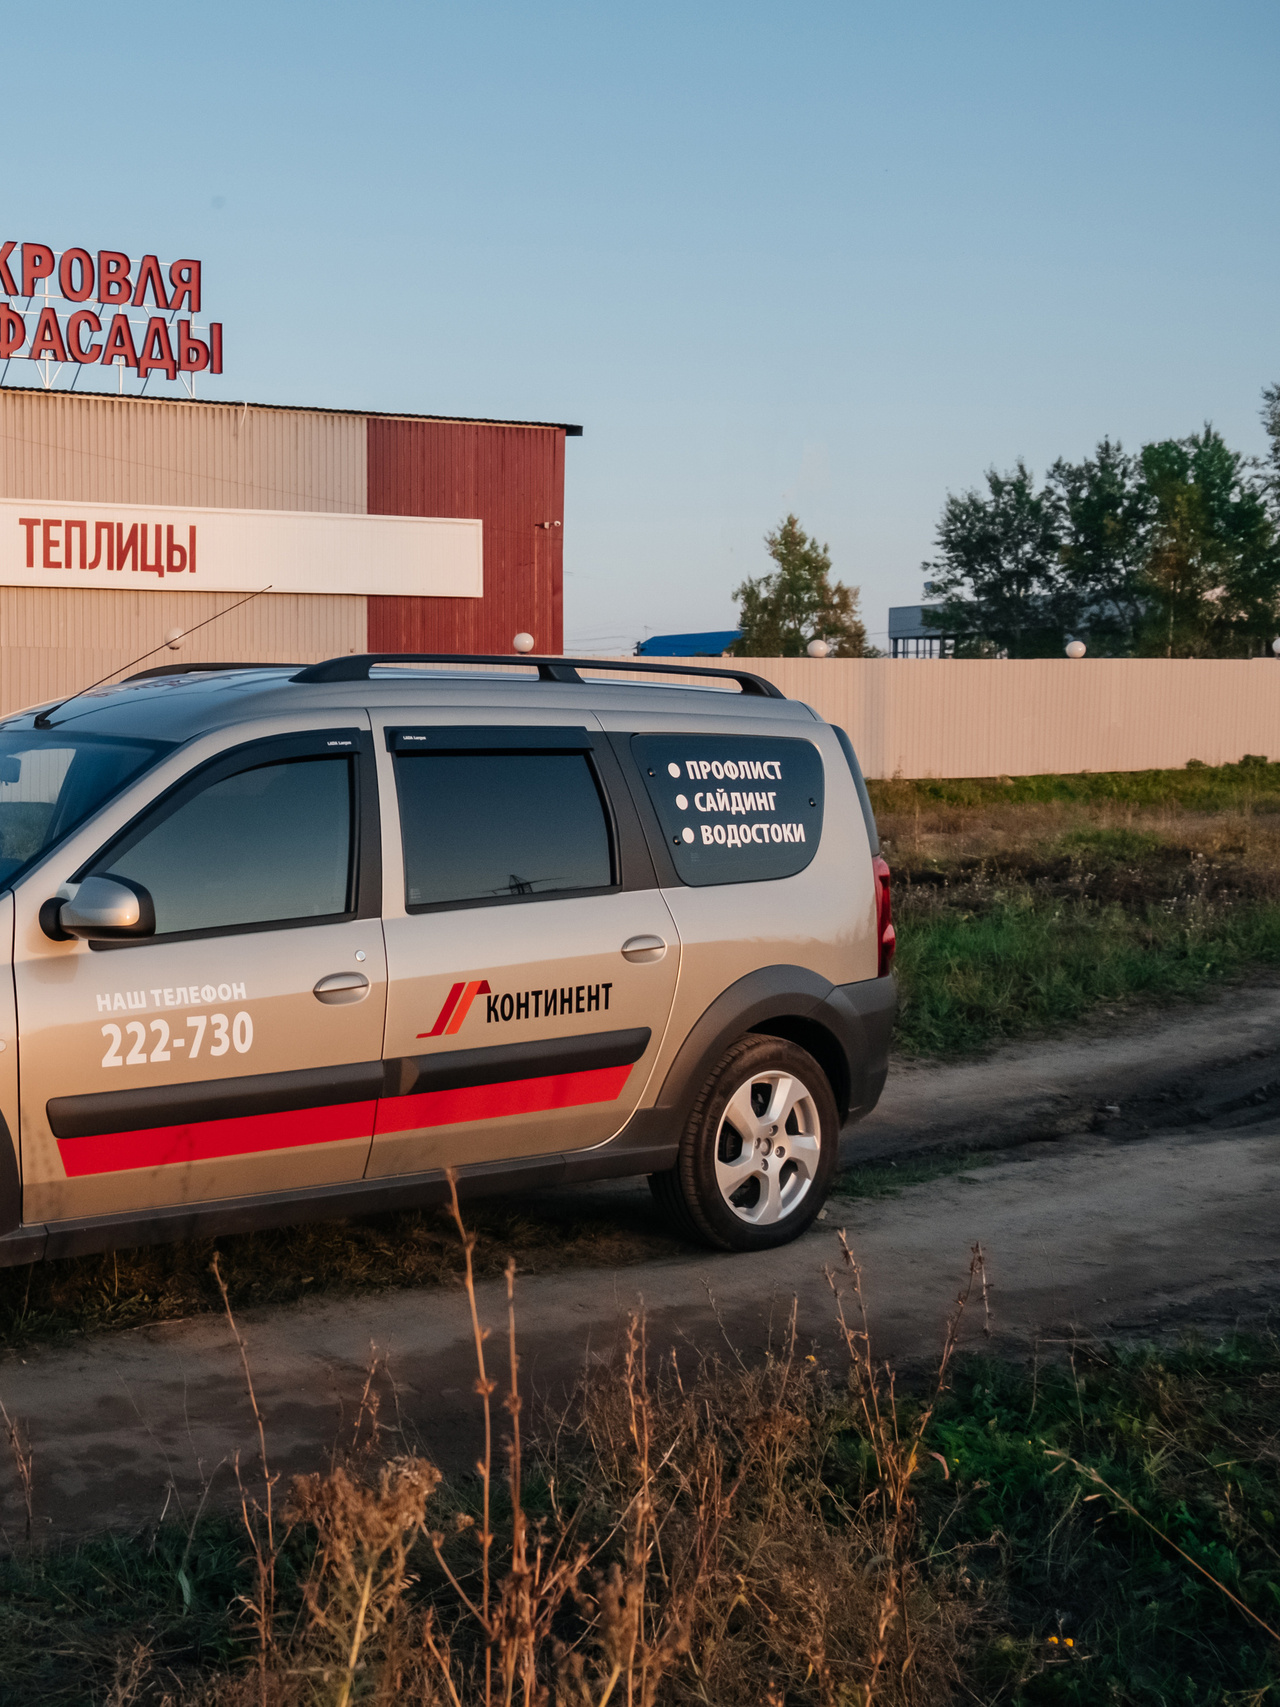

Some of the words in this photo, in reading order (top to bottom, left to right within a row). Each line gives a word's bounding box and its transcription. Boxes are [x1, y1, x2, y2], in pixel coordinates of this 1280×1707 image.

[19, 517, 196, 578] ТЕПЛИЦЫ
[685, 760, 782, 780] ПРОФЛИСТ
[694, 788, 777, 815] САЙДИНГ
[700, 823, 806, 848] ВОДОСТОКИ
[96, 990, 147, 1012] НАШ
[150, 982, 247, 1007] ТЕЛЕФОН
[486, 982, 613, 1023] КОНТИНЕНТ
[101, 1011, 254, 1068] 222-730
